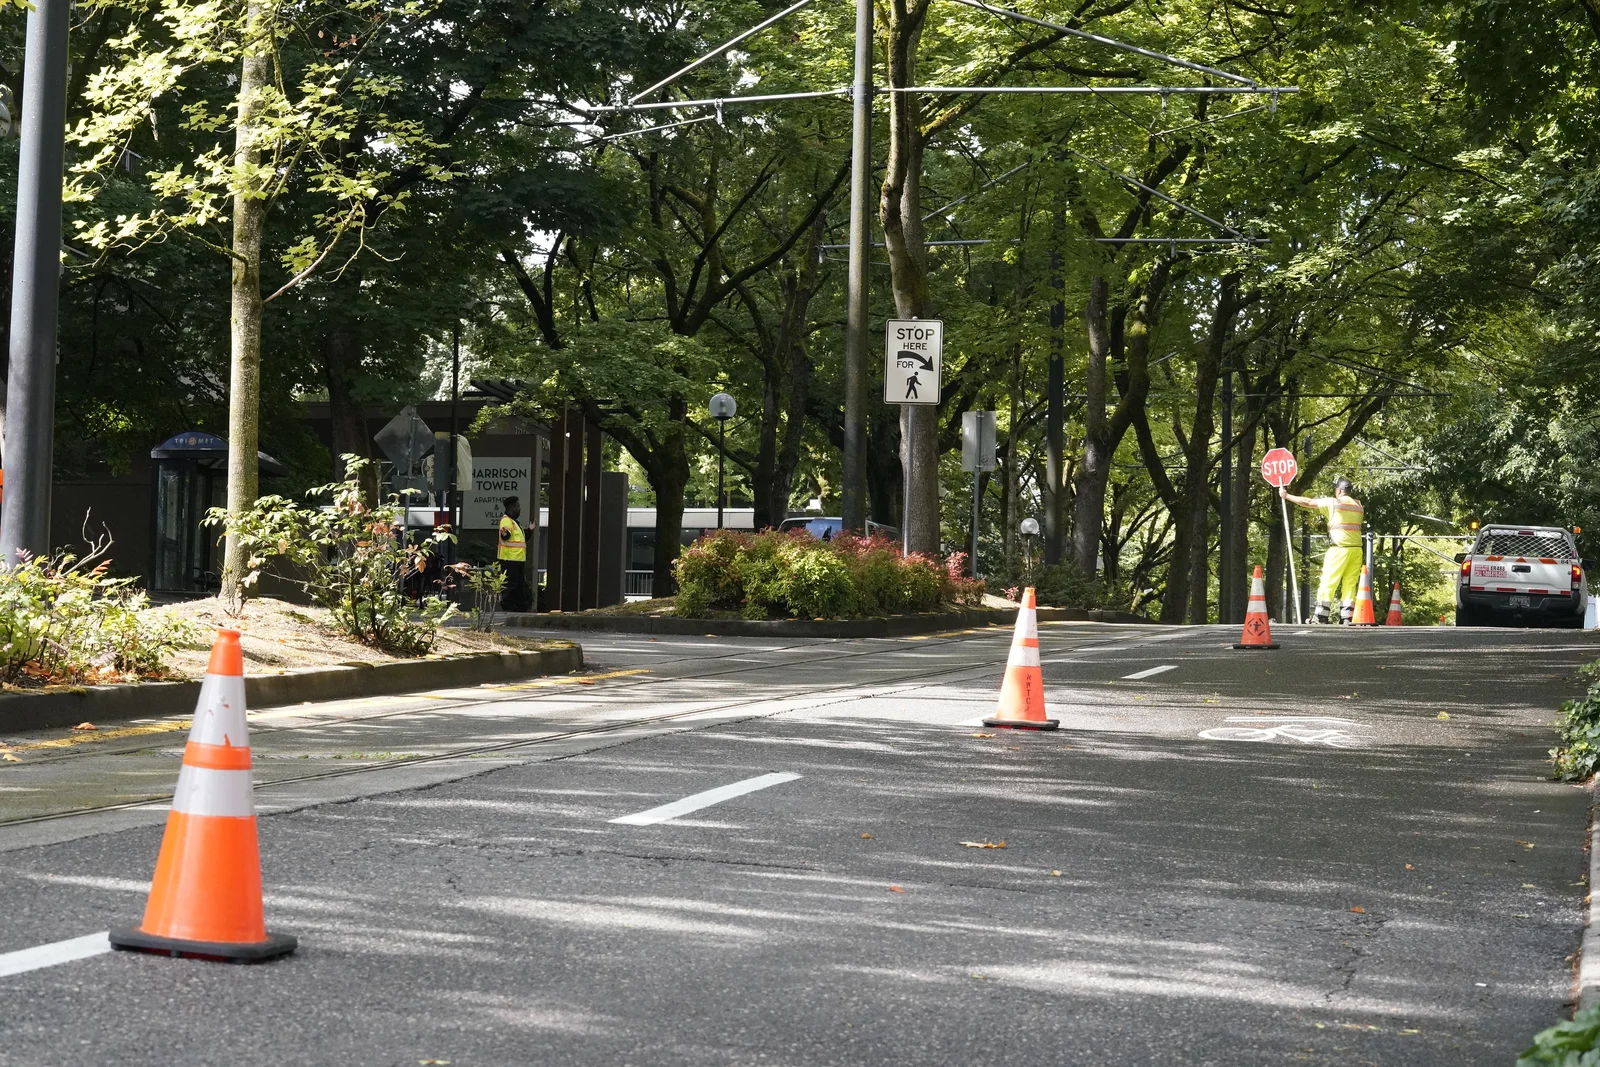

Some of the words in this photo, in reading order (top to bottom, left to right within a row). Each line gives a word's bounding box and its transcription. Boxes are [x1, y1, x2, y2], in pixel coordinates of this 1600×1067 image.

[896, 328, 935, 340] STOP
[903, 342, 927, 350] HERE
[896, 360, 914, 368] FOR
[1263, 459, 1295, 476] STOP
[476, 481, 518, 491] TOWER
